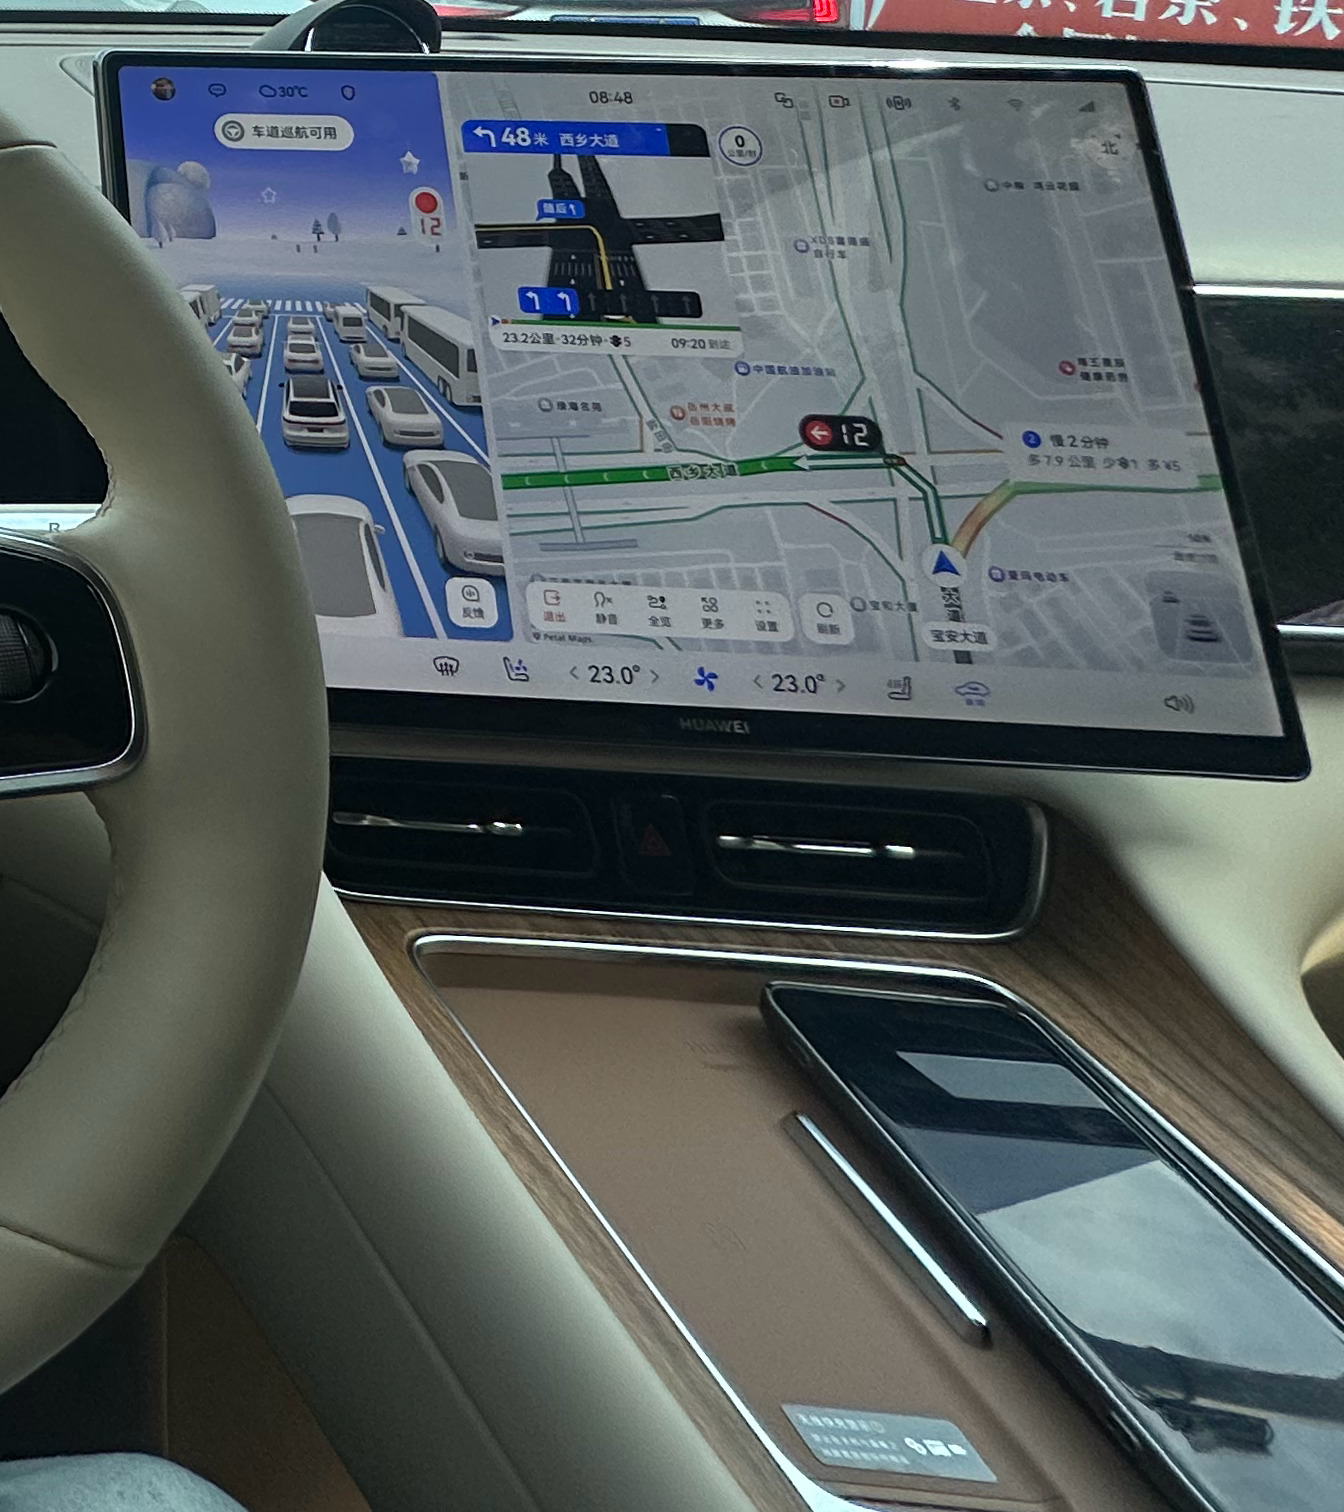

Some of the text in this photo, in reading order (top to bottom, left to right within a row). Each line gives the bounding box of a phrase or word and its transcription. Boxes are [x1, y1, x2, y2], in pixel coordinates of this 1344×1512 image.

[589, 90, 633, 105] 08:48
[251, 124, 338, 140] 车道巡航可用
[559, 132, 620, 148] 西乡大道
[734, 134, 746, 148] 0
[1101, 140, 1119, 155] 北
[420, 217, 442, 236] 12
[842, 423, 869, 447] 12
[670, 464, 738, 480] 西乡大道
[701, 616, 725, 630] 更多
[755, 619, 779, 633] 设置
[929, 629, 988, 645] 宝安大道
[679, 717, 750, 734] HUAWEI
